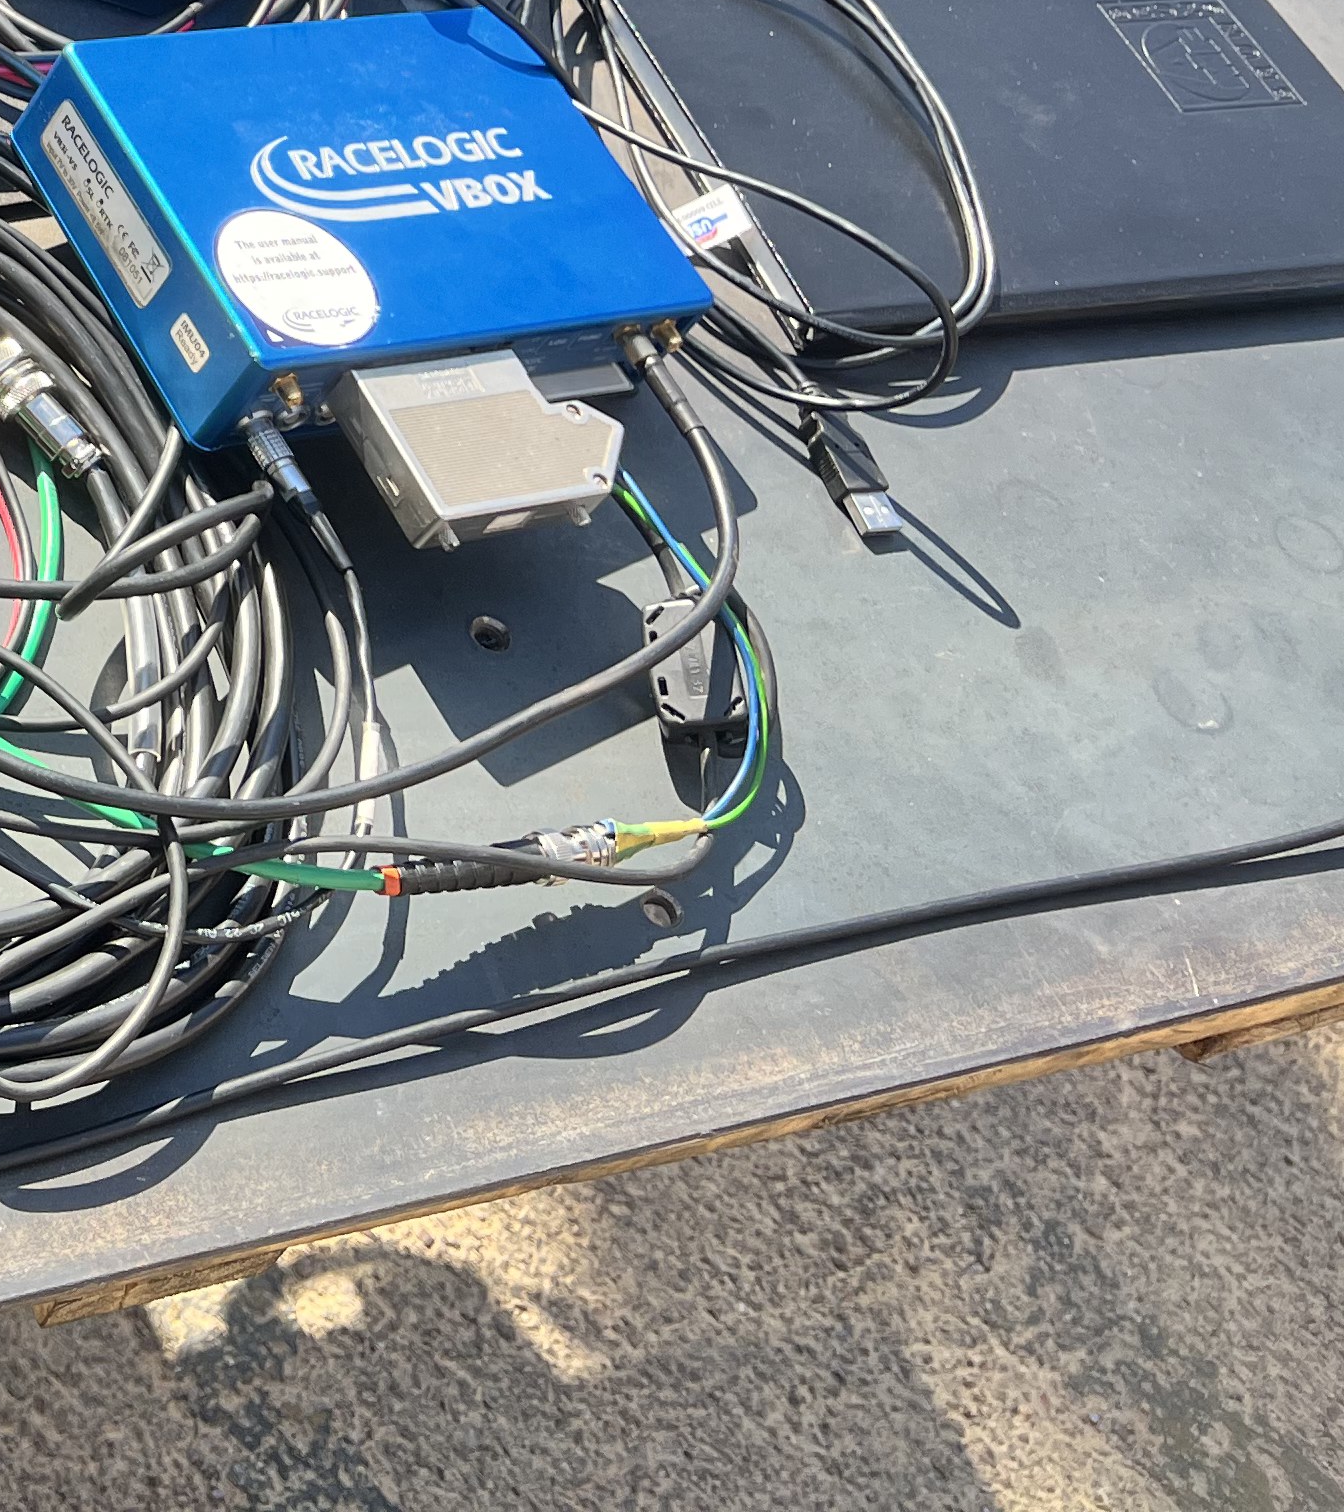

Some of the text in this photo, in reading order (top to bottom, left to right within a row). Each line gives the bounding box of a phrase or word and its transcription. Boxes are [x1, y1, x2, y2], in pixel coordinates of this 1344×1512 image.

[58, 114, 116, 200] RACELOGIC
[287, 127, 524, 180] RACELOGIC
[420, 170, 553, 211] VBOX
[234, 235, 318, 250] The user manual
[687, 216, 713, 238] US
[264, 252, 307, 264] available
[309, 251, 321, 260] at
[293, 306, 360, 321] RACELOGIC
[172, 328, 199, 366] Ready
[178, 319, 205, 359] IMU04
